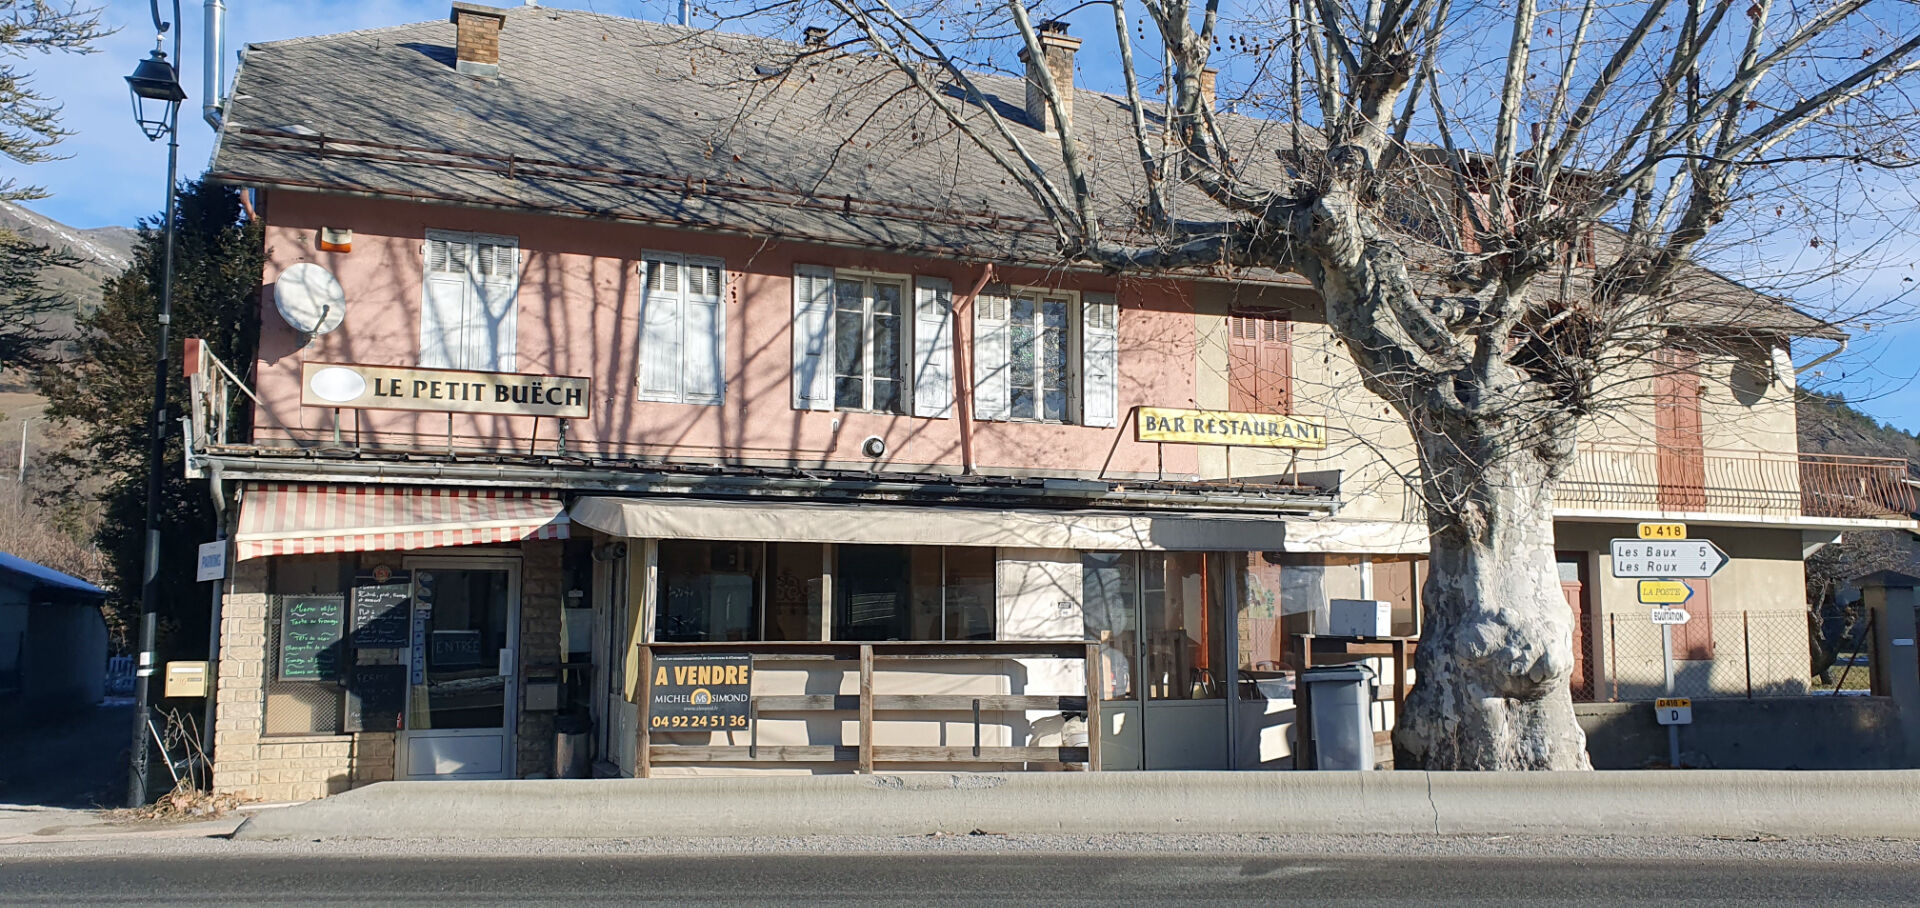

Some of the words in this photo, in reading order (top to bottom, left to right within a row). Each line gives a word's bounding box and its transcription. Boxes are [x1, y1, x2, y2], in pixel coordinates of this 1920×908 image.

[374, 378, 403, 397] LE
[413, 380, 486, 402] PETIT
[494, 382, 581, 407] BUËCH
[1146, 415, 1186, 433] BAR
[1194, 418, 1321, 439] RESTAURANT
[1644, 526, 1651, 536] D
[1657, 526, 1681, 536] 418
[1618, 546, 1638, 557] Les
[1646, 546, 1677, 557] Baux
[1699, 546, 1706, 557] 5
[1619, 561, 1639, 572] Les
[1647, 561, 1677, 572] Roux
[1700, 561, 1706, 572] 4
[1642, 587, 1653, 597] LA
[1655, 587, 1681, 597] POSTE
[1654, 611, 1683, 621] EQUITATION
[655, 666, 668, 686] A
[674, 665, 748, 686] VENDRE
[654, 694, 690, 703] MICHEL
[711, 693, 748, 703] SIMOND
[652, 715, 669, 728] 04
[671, 715, 688, 727] 92
[691, 715, 708, 727] 24
[710, 715, 725, 727] 51
[729, 714, 746, 727] 36
[1671, 711, 1679, 721] D
